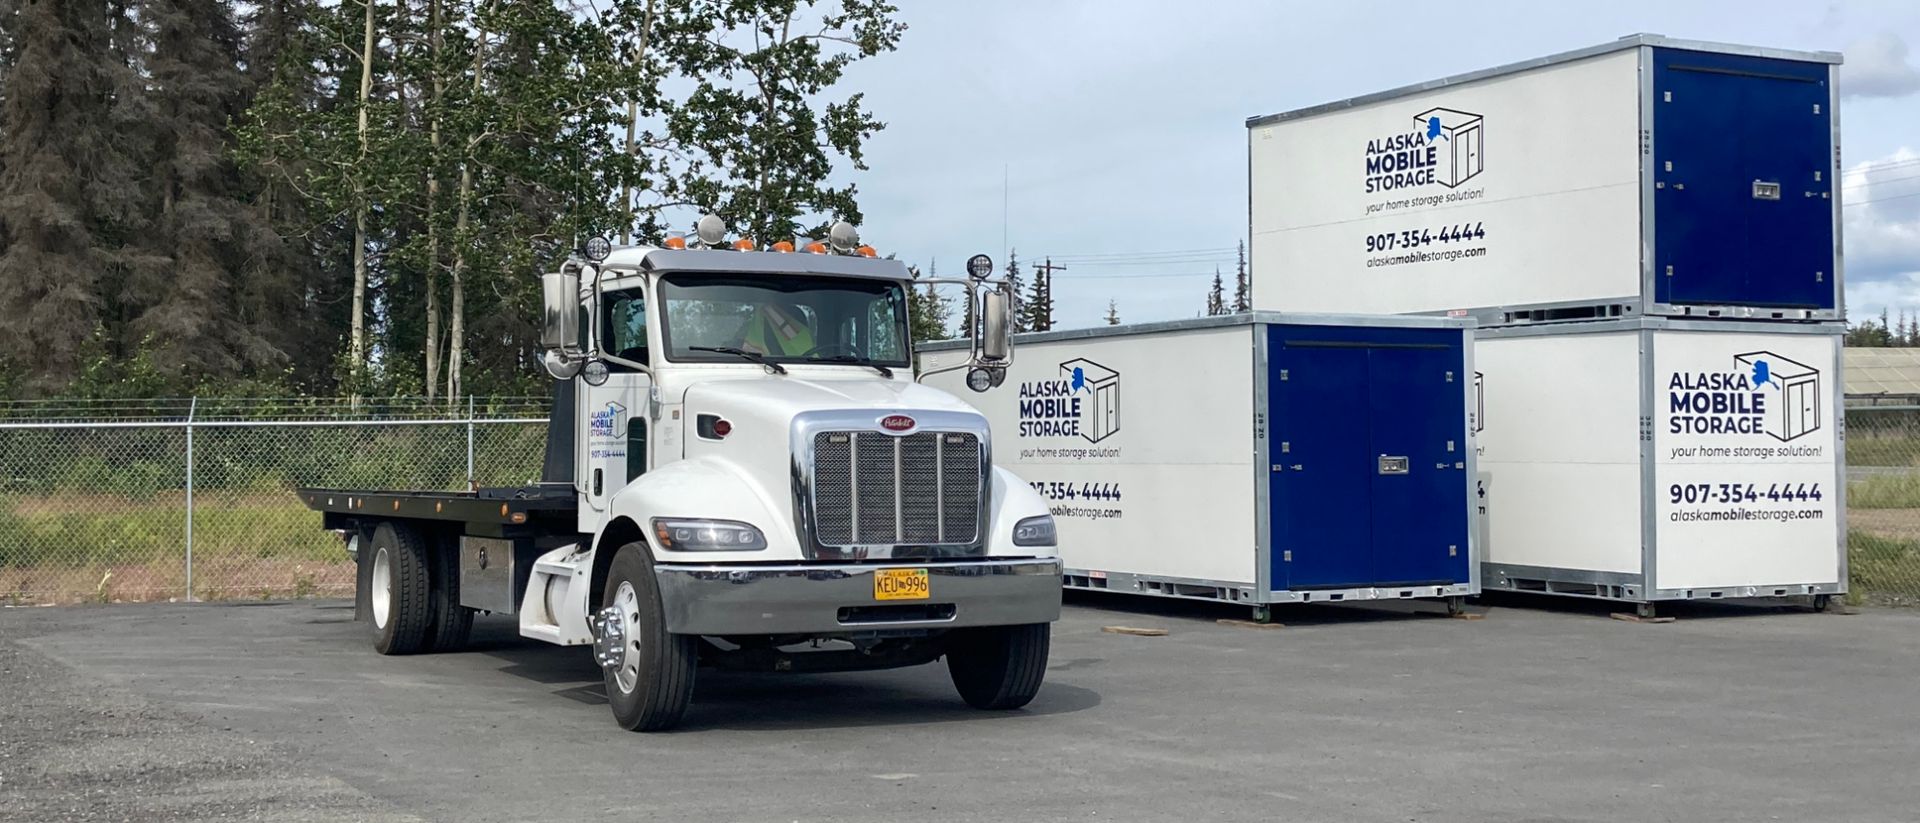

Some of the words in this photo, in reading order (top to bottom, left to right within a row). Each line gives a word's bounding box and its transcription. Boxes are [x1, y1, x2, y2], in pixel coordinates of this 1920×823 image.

[1366, 132, 1425, 156] ALASKA
[1366, 146, 1437, 176] MOBILE
[1366, 168, 1435, 193] STORAGE
[1366, 203, 1385, 215] your
[1386, 200, 1410, 210] home
[1411, 194, 1444, 206] storage
[1446, 188, 1485, 202] solution!
[1366, 222, 1485, 252] 907-354-4444
[1367, 247, 1486, 268] alaskamobilestorage.com
[1019, 380, 1070, 398] ALASKA
[1669, 372, 1750, 390] ALASKA
[1020, 398, 1081, 419] MOBILE
[1670, 392, 1765, 414] MOBILE
[591, 419, 613, 428] MOBILE
[1020, 420, 1079, 437] STORAGE
[1670, 416, 1763, 434] STORAGE
[1020, 448, 1035, 460] your
[1037, 447, 1057, 457] home
[1058, 448, 1087, 460] storage
[1089, 446, 1121, 458] solution!
[1671, 447, 1696, 459] your
[1700, 445, 1731, 457] home
[1733, 446, 1775, 459] storage
[1777, 445, 1822, 457] solution!
[1029, 482, 1121, 501] 7-354-4444
[1670, 483, 1822, 504] 907-354-4444
[1050, 505, 1122, 520] obilestorage.com
[1670, 507, 1823, 522] alaskamobilestorage.com
[877, 577, 898, 592] KEU
[906, 577, 927, 591] 996
